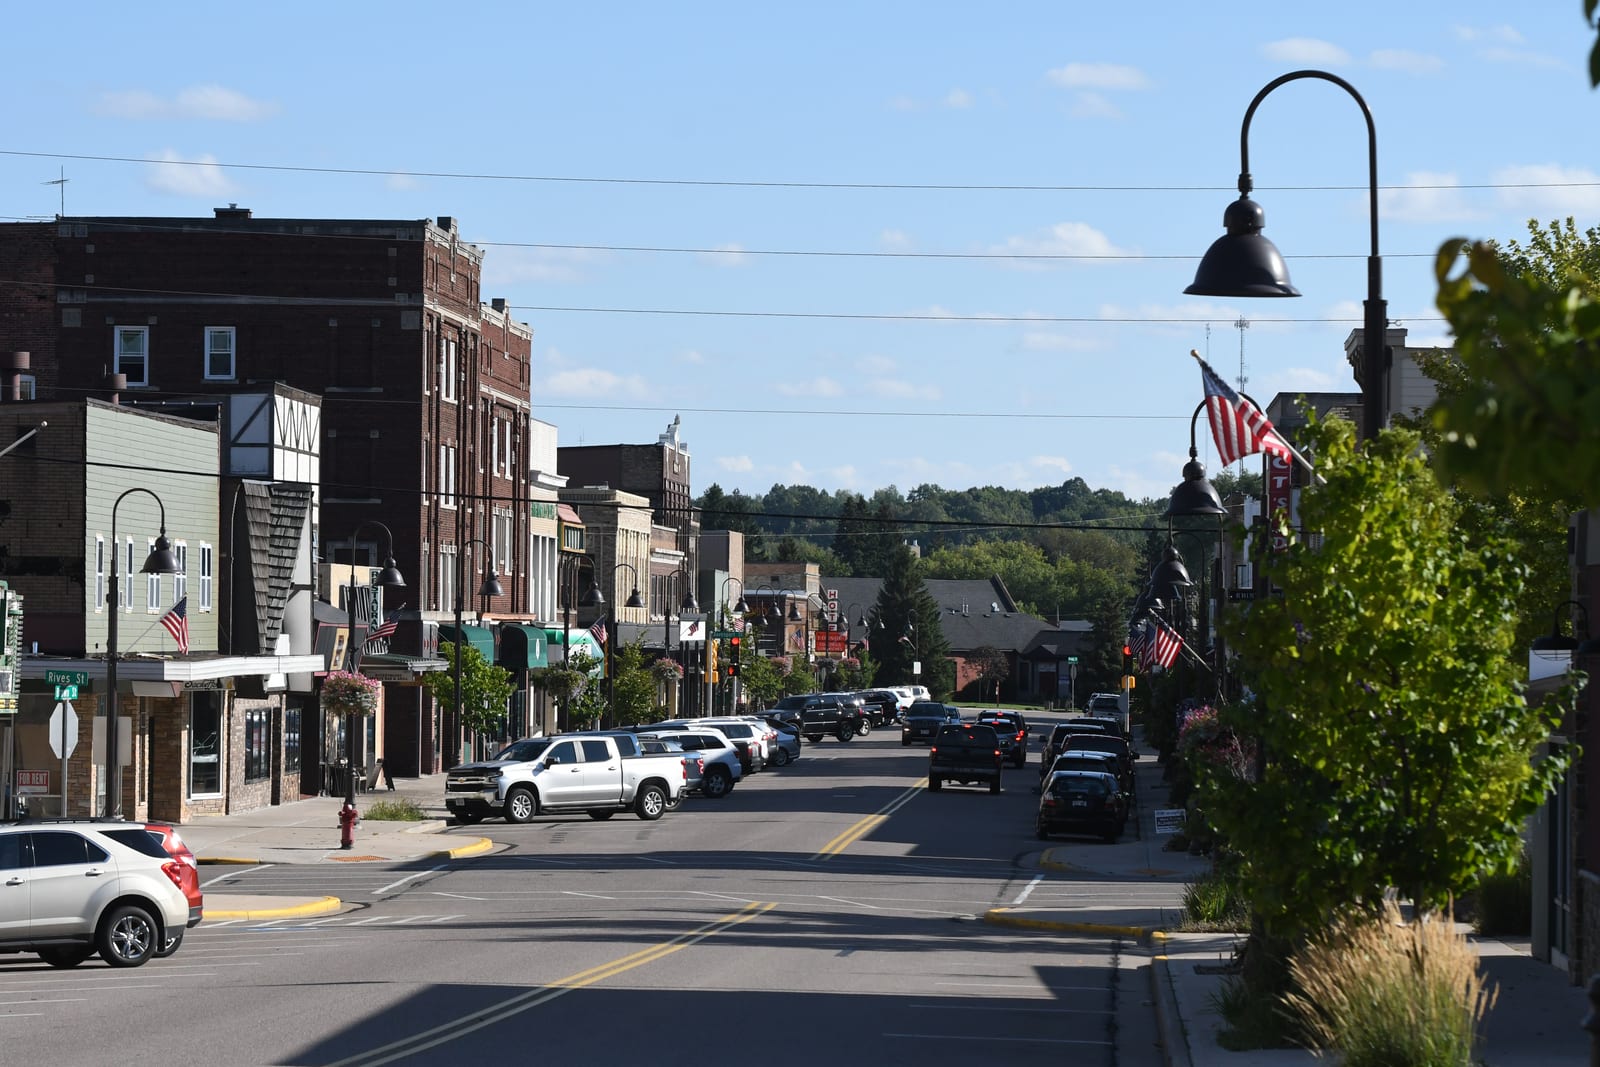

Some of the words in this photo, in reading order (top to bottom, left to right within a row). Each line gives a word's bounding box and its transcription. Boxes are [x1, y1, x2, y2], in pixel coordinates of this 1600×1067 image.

[371, 571, 379, 633] RESTAURAN
[828, 590, 836, 631] HOTE
[48, 671, 70, 683] Rives
[76, 673, 85, 685] St
[19, 772, 31, 785] FOR
[31, 772, 48, 785] RENT
